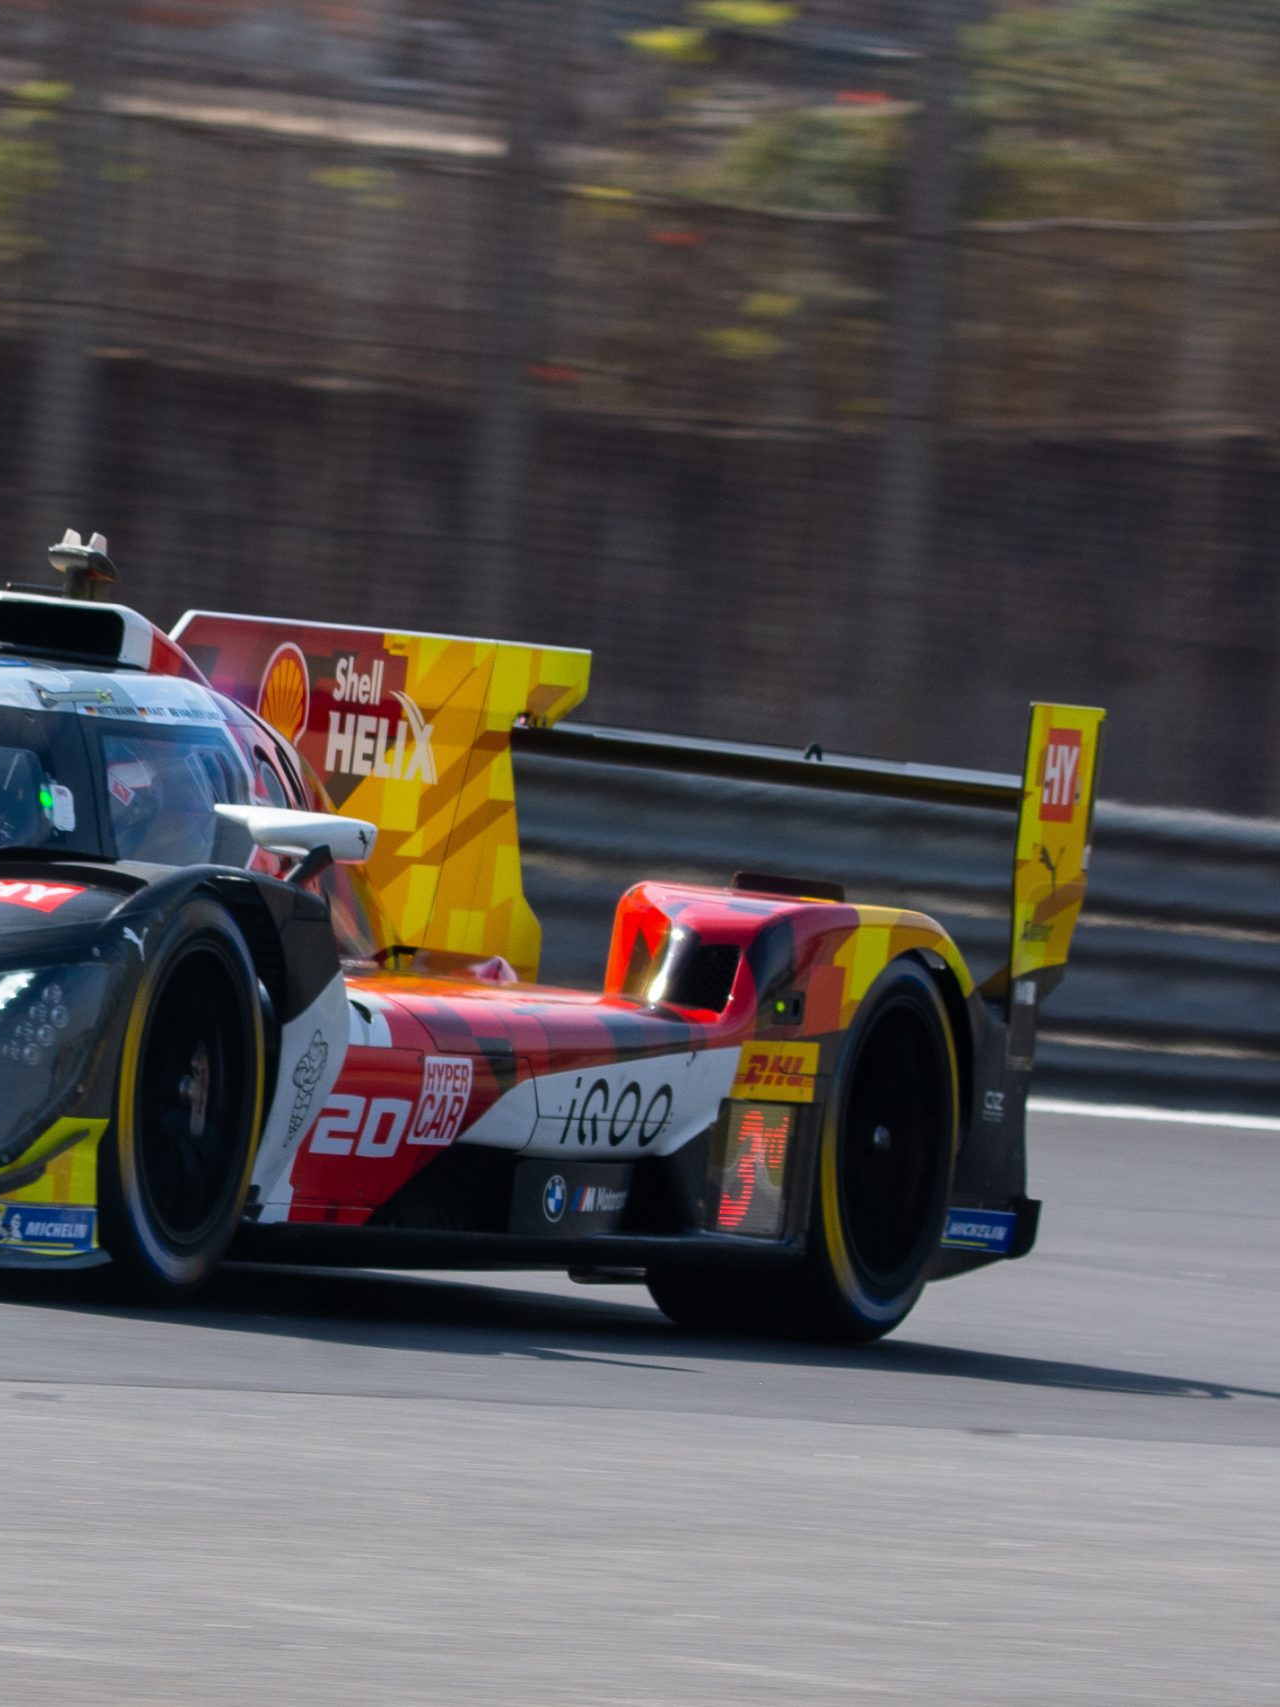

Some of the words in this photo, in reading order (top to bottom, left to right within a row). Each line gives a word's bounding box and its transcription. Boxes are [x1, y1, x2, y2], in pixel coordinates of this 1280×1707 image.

[333, 656, 384, 706] Shell
[324, 690, 438, 785] HELIX
[1042, 744, 1079, 806] HY
[426, 1063, 471, 1094] HYPER
[743, 1054, 805, 1087] DHL
[309, 1094, 412, 1157] 20
[413, 1094, 464, 1140] CAR
[24, 1222, 89, 1239] MICHELIN
[949, 1221, 1008, 1241] MICHELIN
